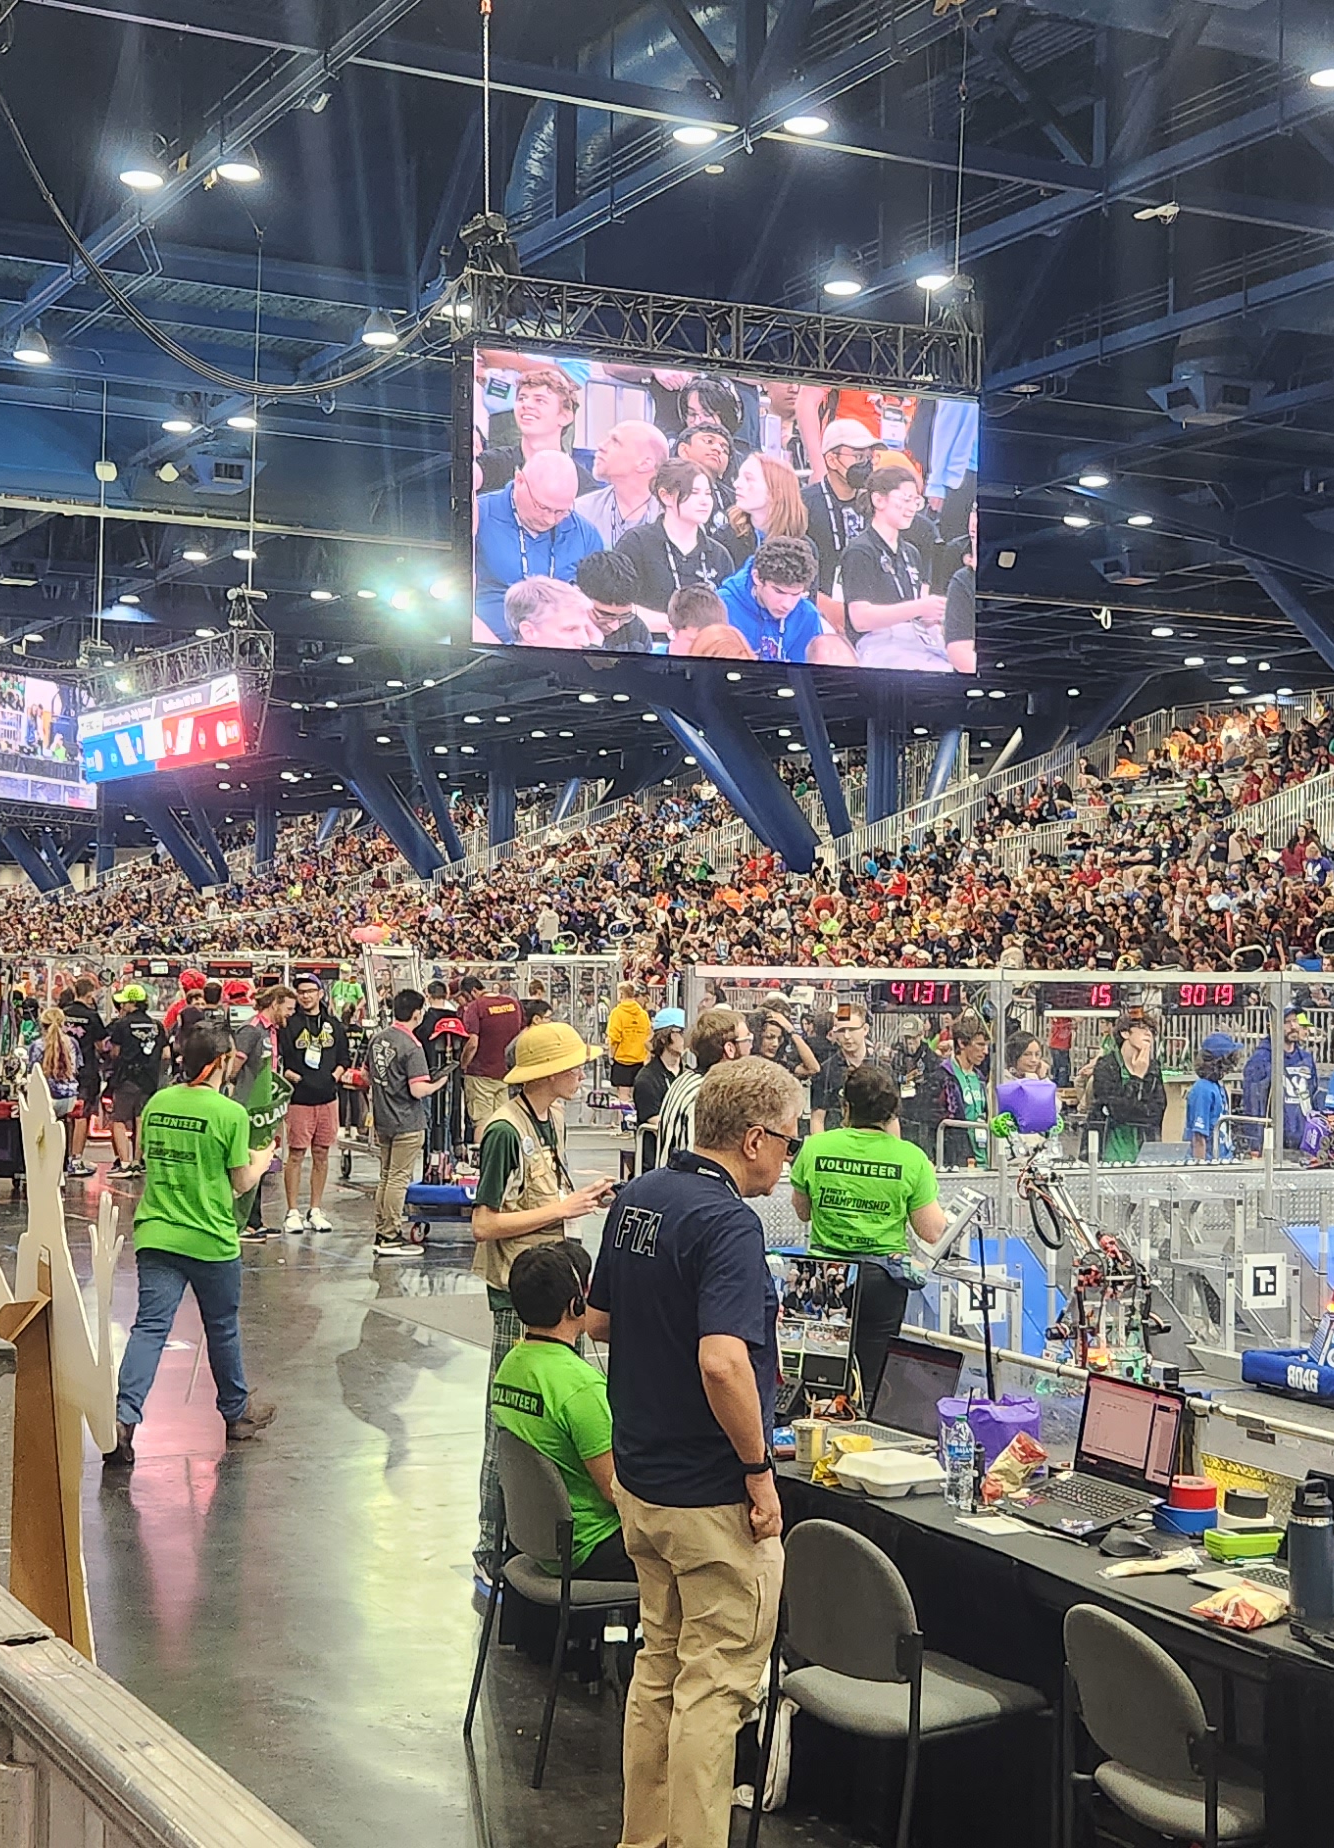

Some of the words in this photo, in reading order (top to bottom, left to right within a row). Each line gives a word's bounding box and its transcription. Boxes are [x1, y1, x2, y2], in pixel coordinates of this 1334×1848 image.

[889, 982, 951, 1006] 4131
[1091, 984, 1111, 1007] 15
[1179, 984, 1234, 1007] 9019
[149, 1115, 203, 1131] VOLUNTEER
[819, 1158, 897, 1178] VOLUNTEER
[822, 1194, 891, 1212] CHAMPIONSHIP
[615, 1205, 664, 1258] FTA
[1286, 1364, 1318, 1393] 8046
[494, 1388, 539, 1414] OLUNTEER
